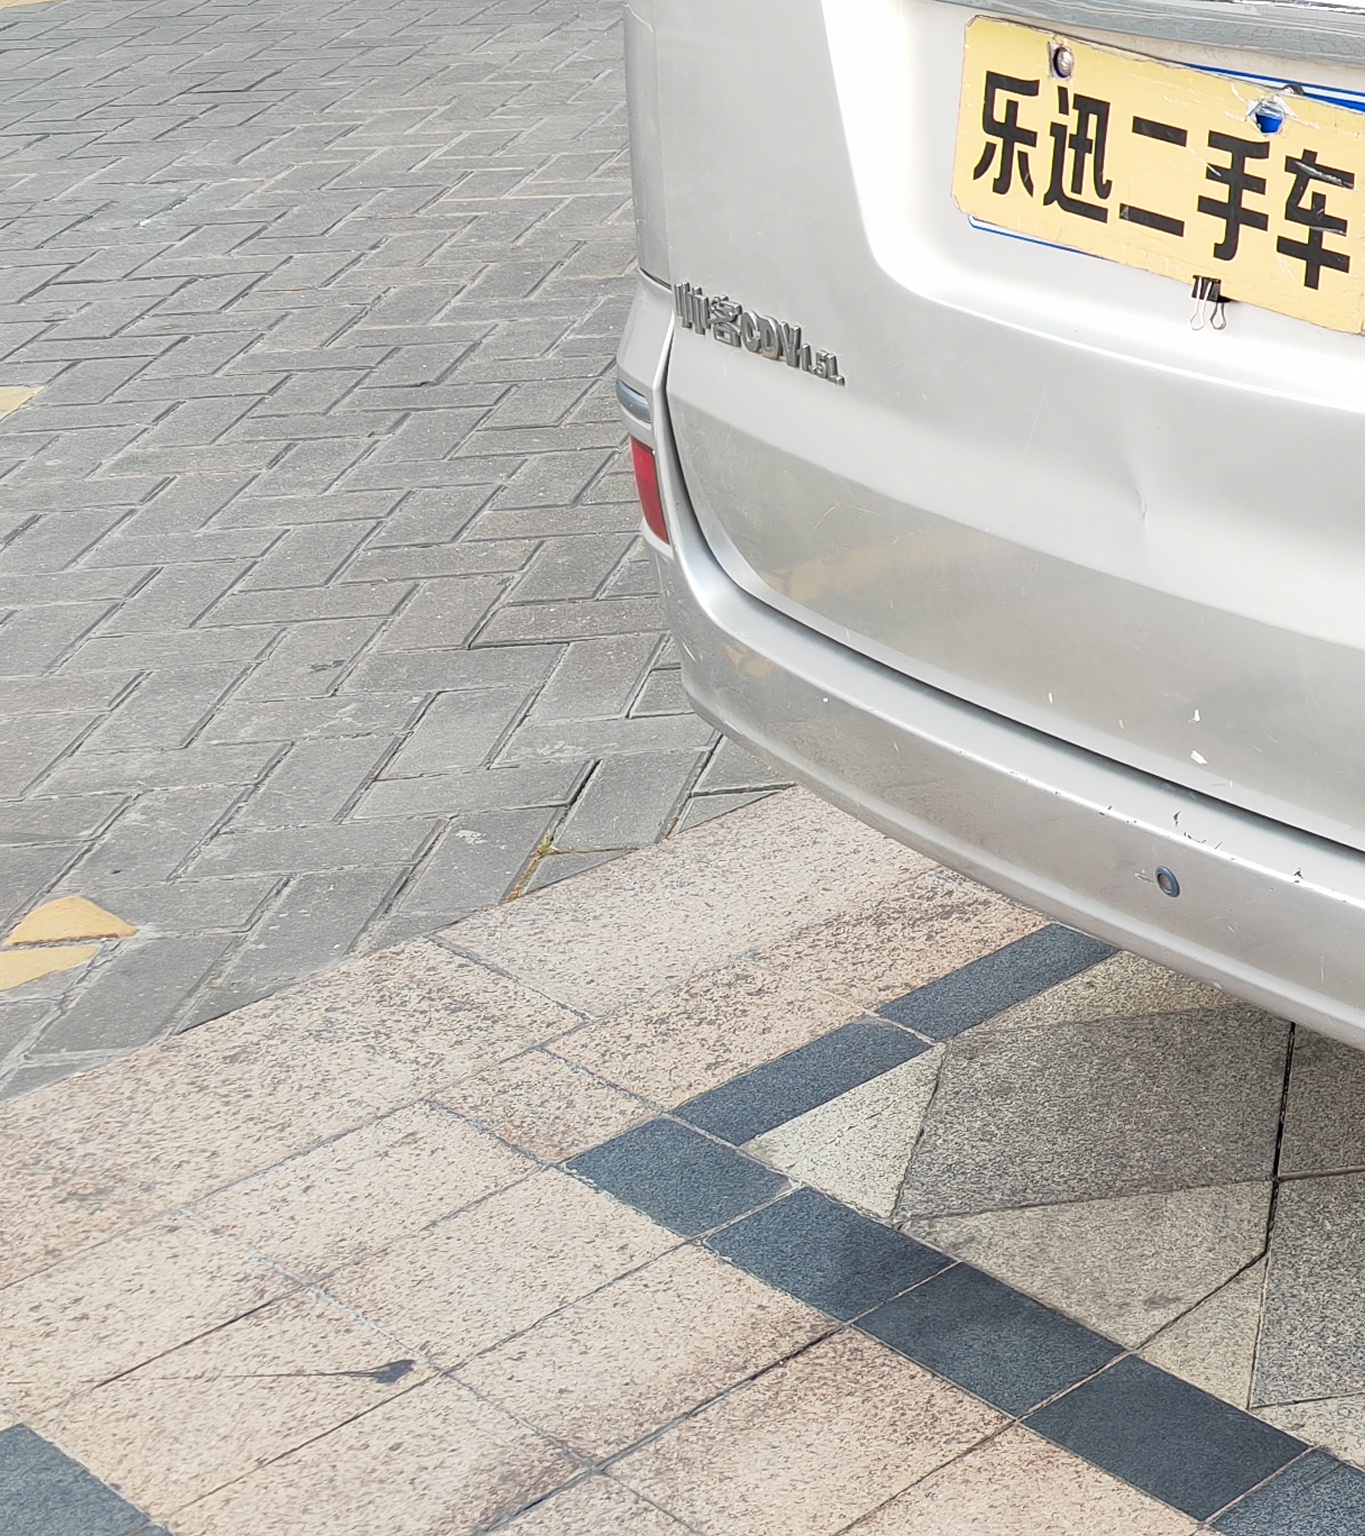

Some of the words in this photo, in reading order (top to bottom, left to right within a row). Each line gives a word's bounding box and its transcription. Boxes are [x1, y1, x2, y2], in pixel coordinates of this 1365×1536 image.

[972, 70, 1356, 291] 乐迅二手车
